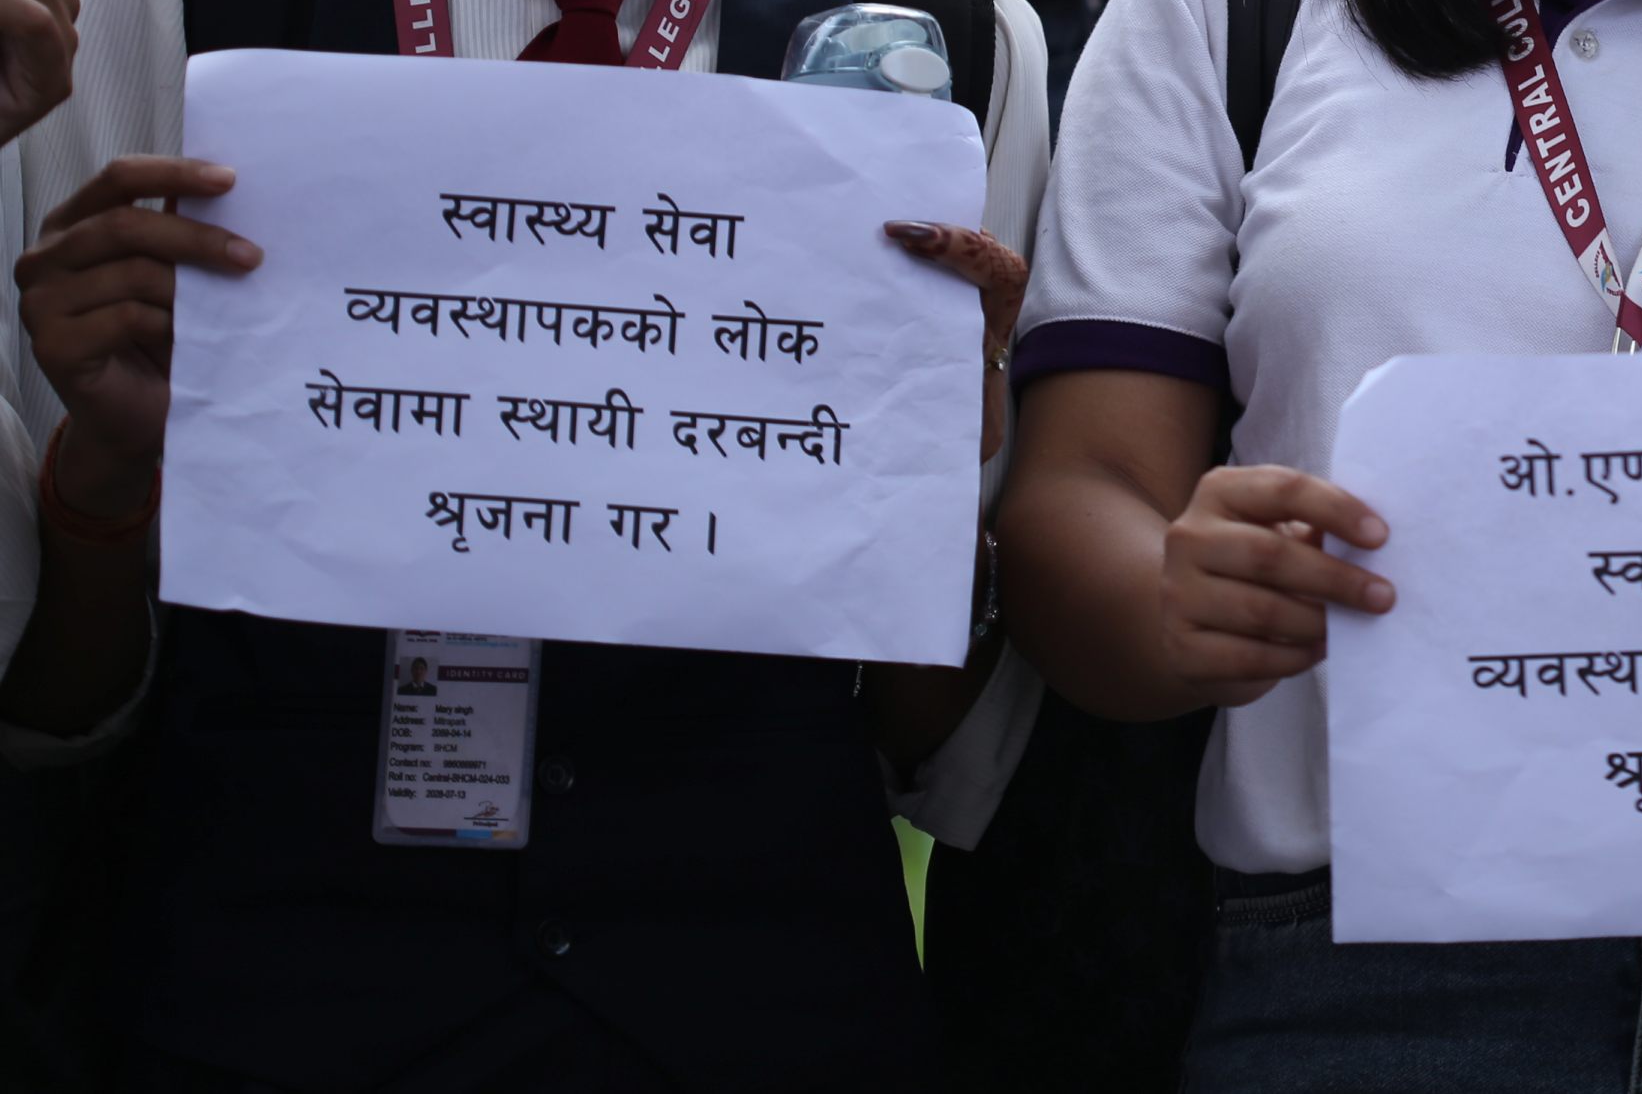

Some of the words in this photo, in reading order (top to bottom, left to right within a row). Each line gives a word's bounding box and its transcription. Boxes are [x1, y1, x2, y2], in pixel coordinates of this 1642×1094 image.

[1517, 63, 1591, 228] CENTRAL
[439, 193, 616, 250] स्वास्थ्य
[642, 192, 745, 260] सेवा
[343, 287, 686, 356] व्यवस्थापकको
[711, 299, 825, 365] लोक
[304, 368, 471, 437] सेवामा
[496, 387, 645, 451] स्थायी
[669, 403, 851, 466] दरबन्दी
[606, 503, 680, 553] गर
[446, 668, 493, 679] IDENTITY
[497, 672, 526, 681] CARD
